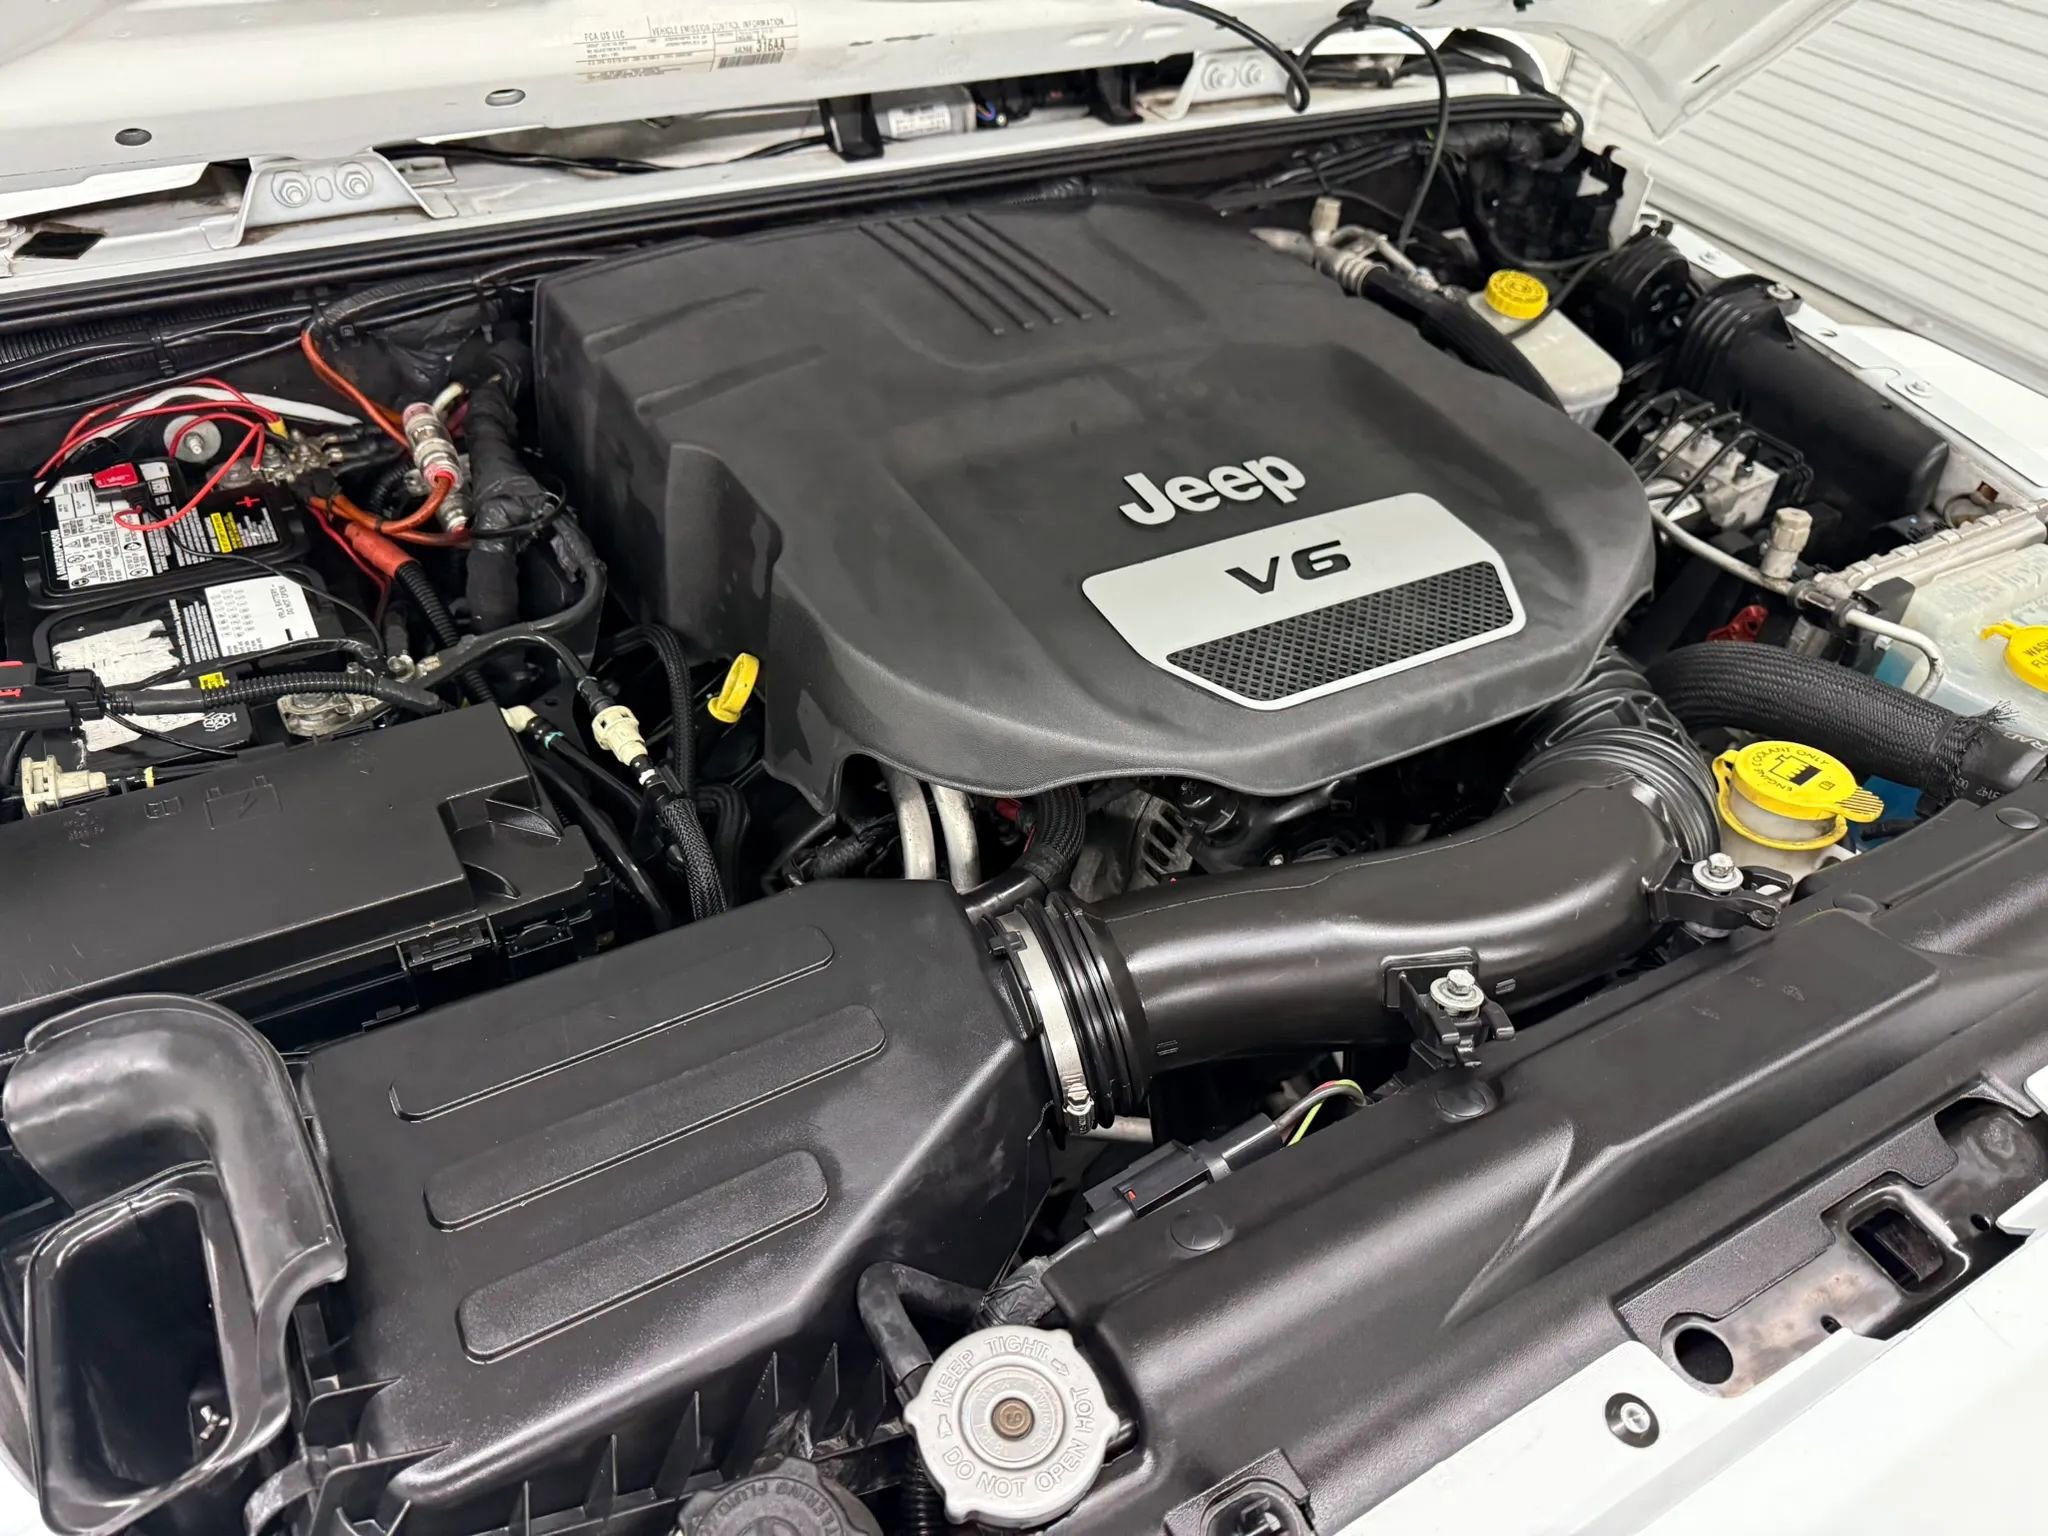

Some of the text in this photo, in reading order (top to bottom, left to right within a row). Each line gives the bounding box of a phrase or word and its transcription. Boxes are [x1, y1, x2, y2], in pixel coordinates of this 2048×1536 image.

[584, 32, 598, 41] FCA
[612, 30, 625, 40] LLC
[743, 17, 785, 29] INFORMATION
[1119, 455, 1306, 526] Jeep
[1225, 540, 1351, 595] V6
[1751, 746, 1791, 767] COOLANT
[1796, 749, 1831, 765] ONLY
[932, 1334, 1054, 1409] KEEP TIGHT
[943, 1446, 976, 1480] DO
[976, 1471, 1026, 1498] NOT
[1034, 1437, 1089, 1493] OPEN
[1070, 1386, 1095, 1434] HOT
[774, 1481, 840, 1536] TEERING
